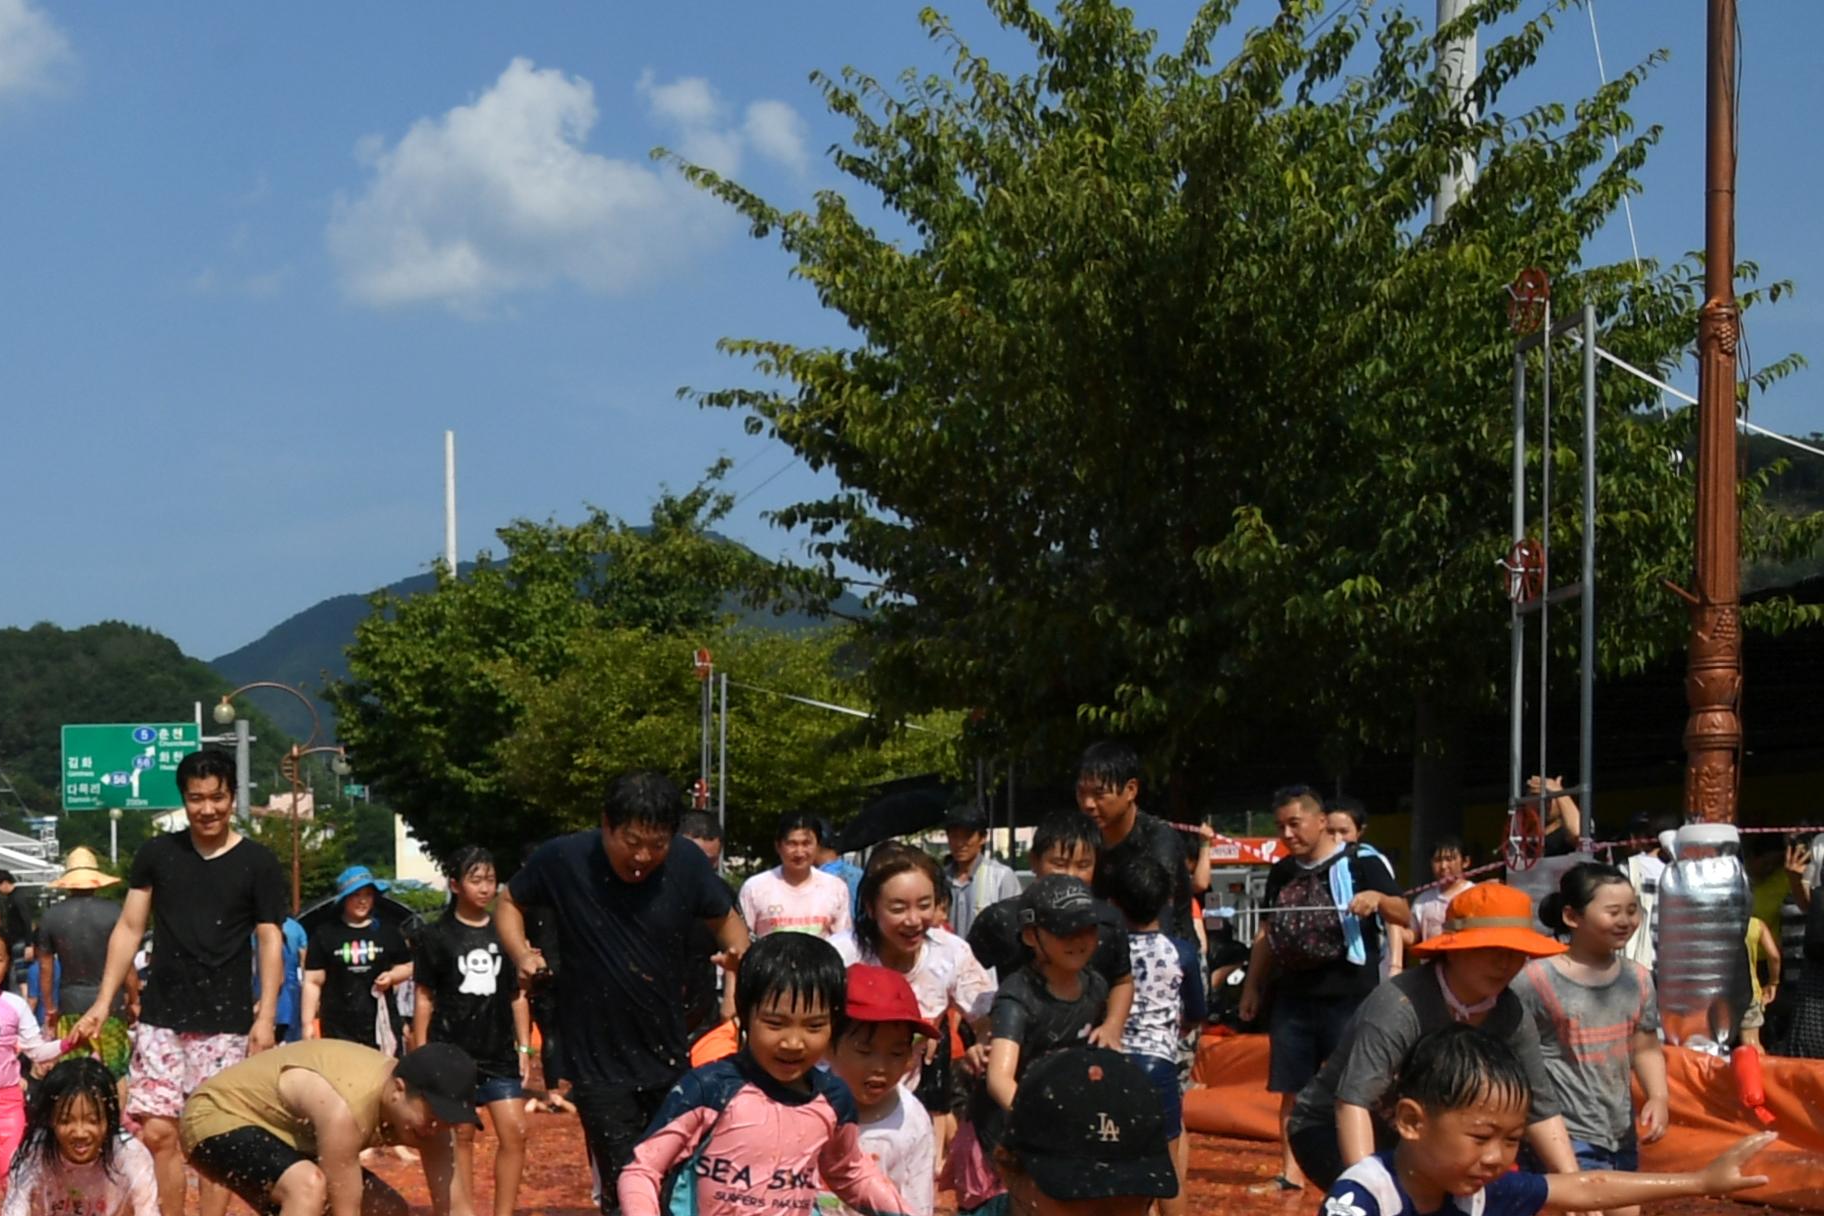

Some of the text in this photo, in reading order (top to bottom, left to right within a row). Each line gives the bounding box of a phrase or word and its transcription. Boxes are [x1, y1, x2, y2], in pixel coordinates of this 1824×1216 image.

[1096, 1112, 1120, 1142] LA
[694, 1155, 752, 1190] SEA
[713, 1191, 766, 1207] SURFERS
